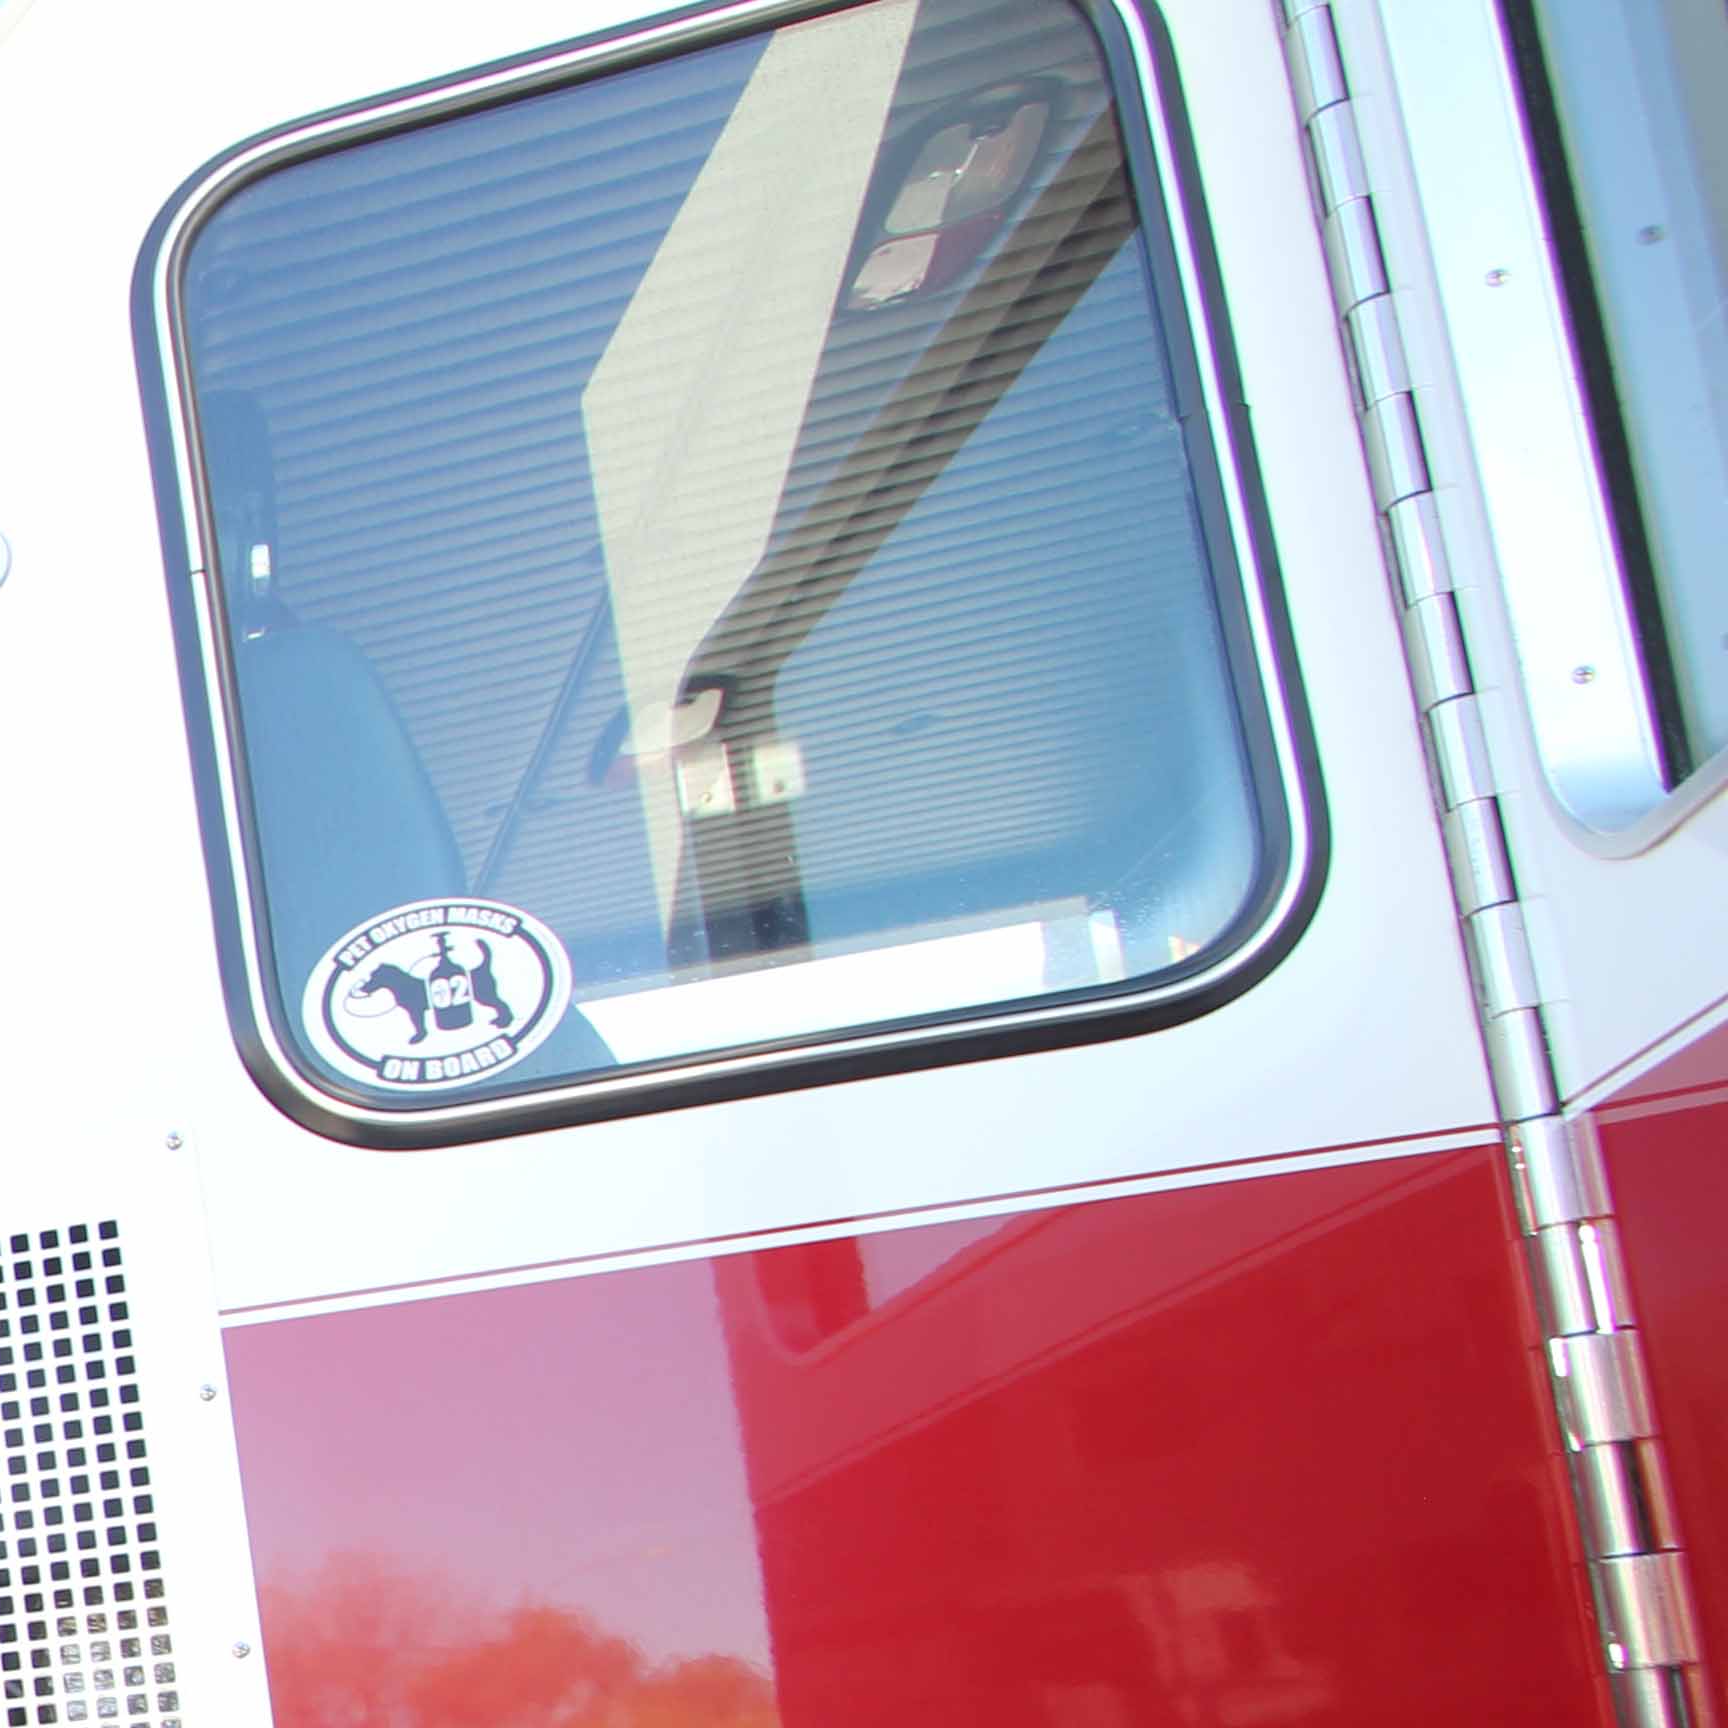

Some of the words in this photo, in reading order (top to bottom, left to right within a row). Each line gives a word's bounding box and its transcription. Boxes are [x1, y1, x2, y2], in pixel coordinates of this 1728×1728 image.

[337, 932, 373, 967] PET
[367, 907, 445, 945] OXYGEN
[447, 906, 518, 935] MASKS
[382, 1057, 421, 1081] ON
[423, 1036, 515, 1081] BOARD
